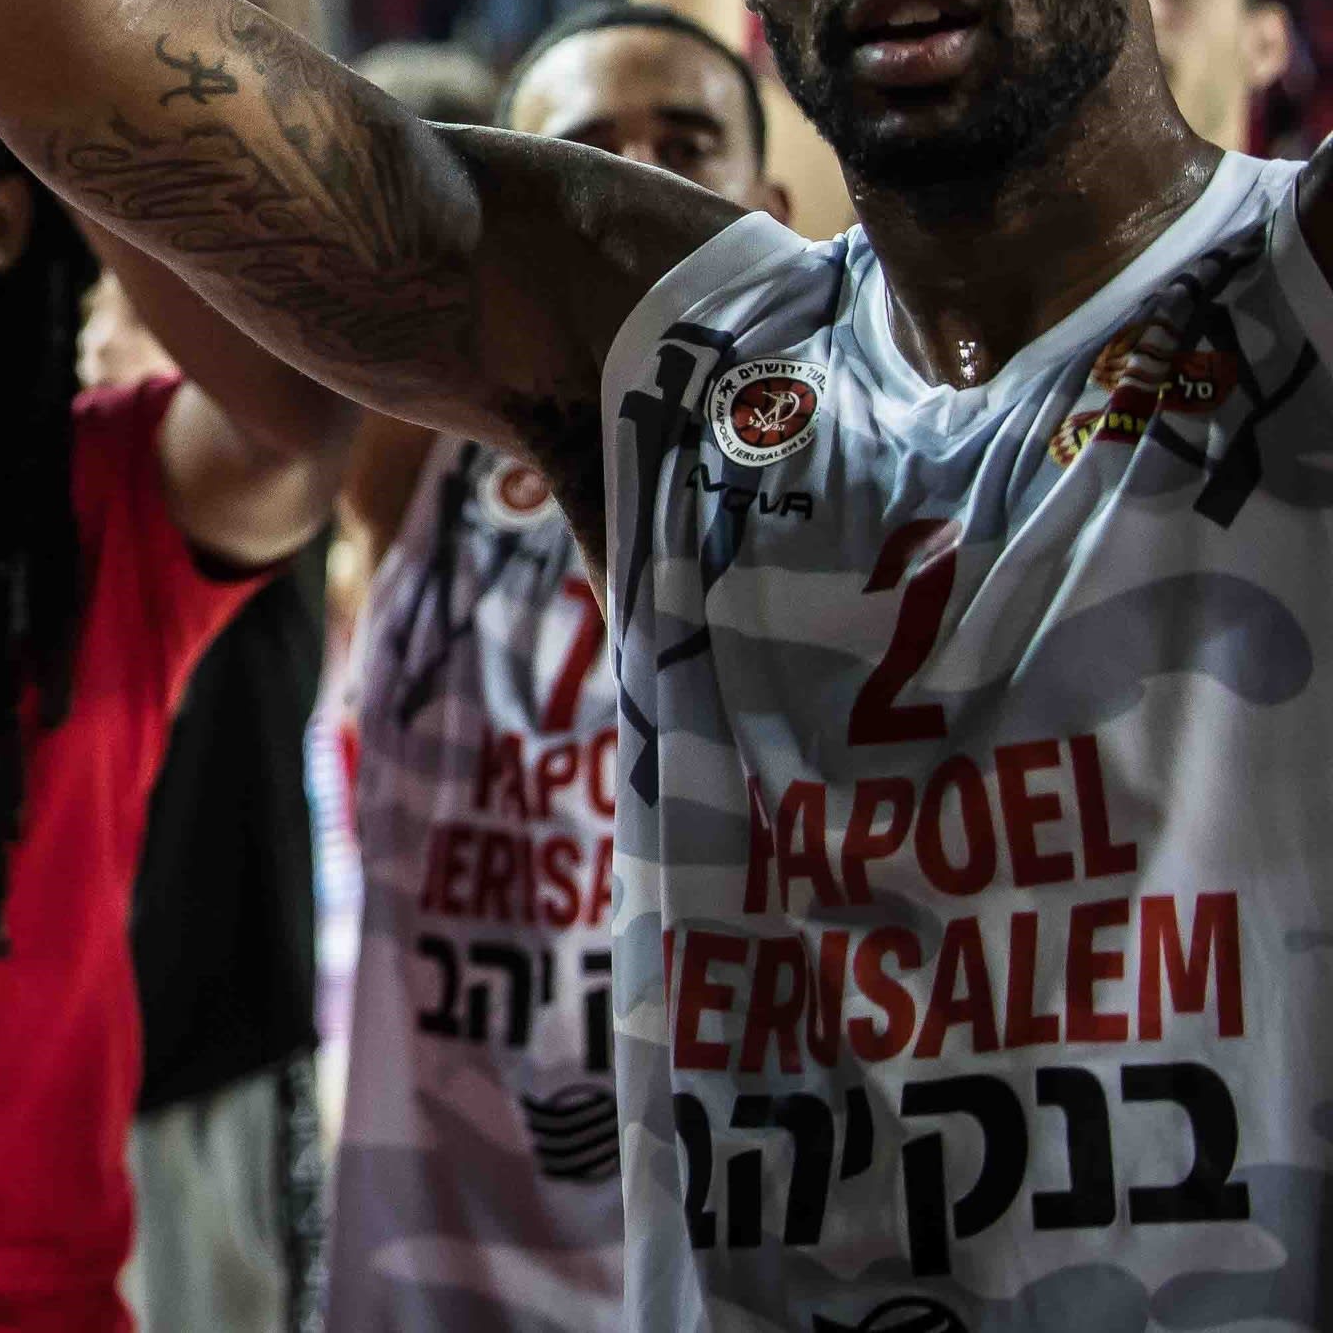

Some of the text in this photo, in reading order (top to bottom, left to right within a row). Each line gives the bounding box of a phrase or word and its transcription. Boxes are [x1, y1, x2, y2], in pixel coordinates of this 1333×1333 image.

[1179, 374, 1213, 399] סל
[847, 518, 962, 747] 2
[901, 1062, 1250, 1277] בנק
